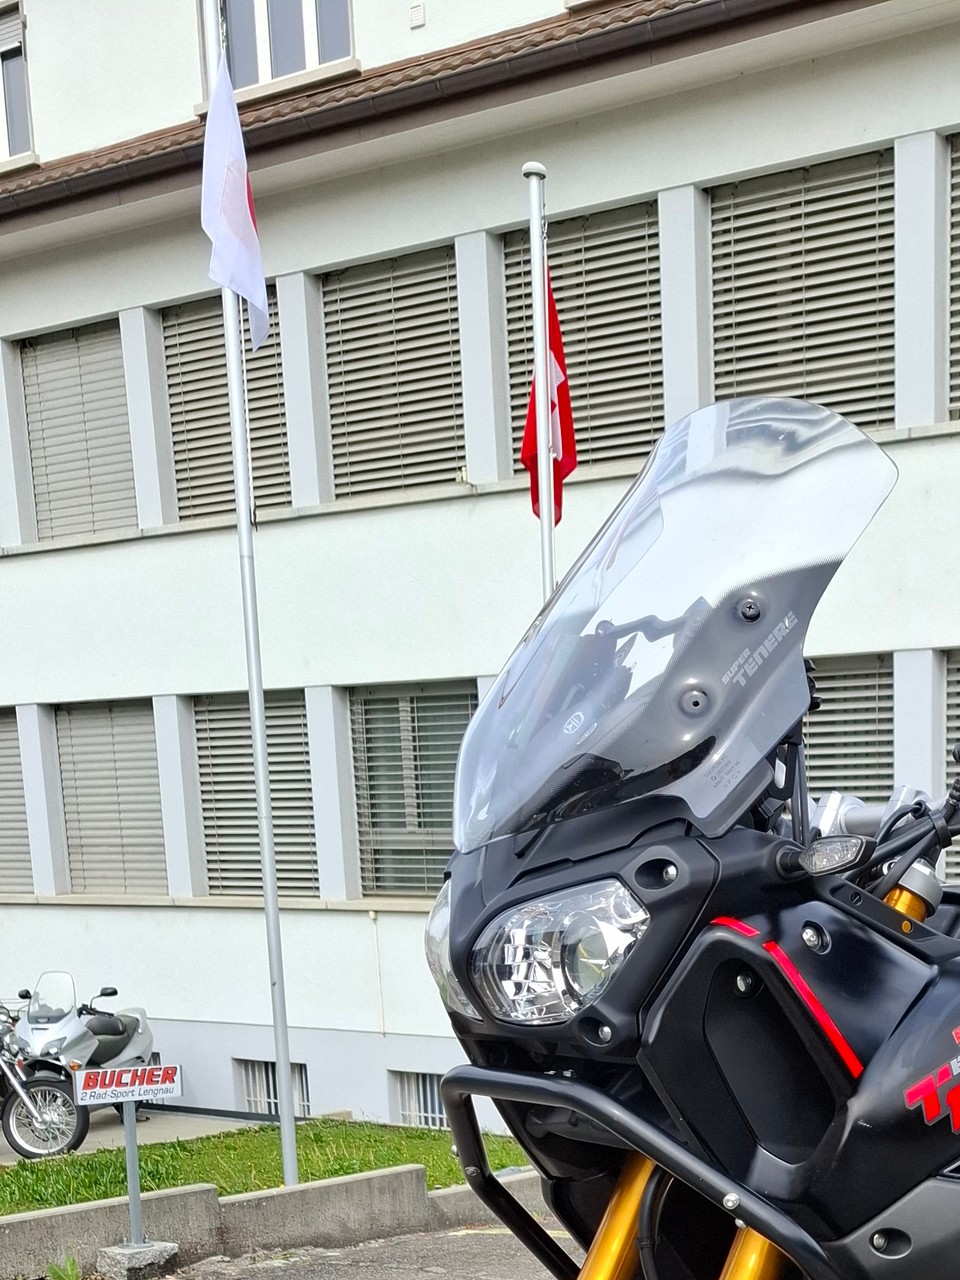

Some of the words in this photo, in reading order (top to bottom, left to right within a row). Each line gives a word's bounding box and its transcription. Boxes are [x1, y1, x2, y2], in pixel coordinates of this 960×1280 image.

[721, 647, 751, 685] SUPER
[82, 1066, 177, 1090] BUCHER
[80, 1092, 88, 1101] 2
[88, 1088, 136, 1100] Rad-Sport
[138, 1086, 175, 1097] Lengnau
